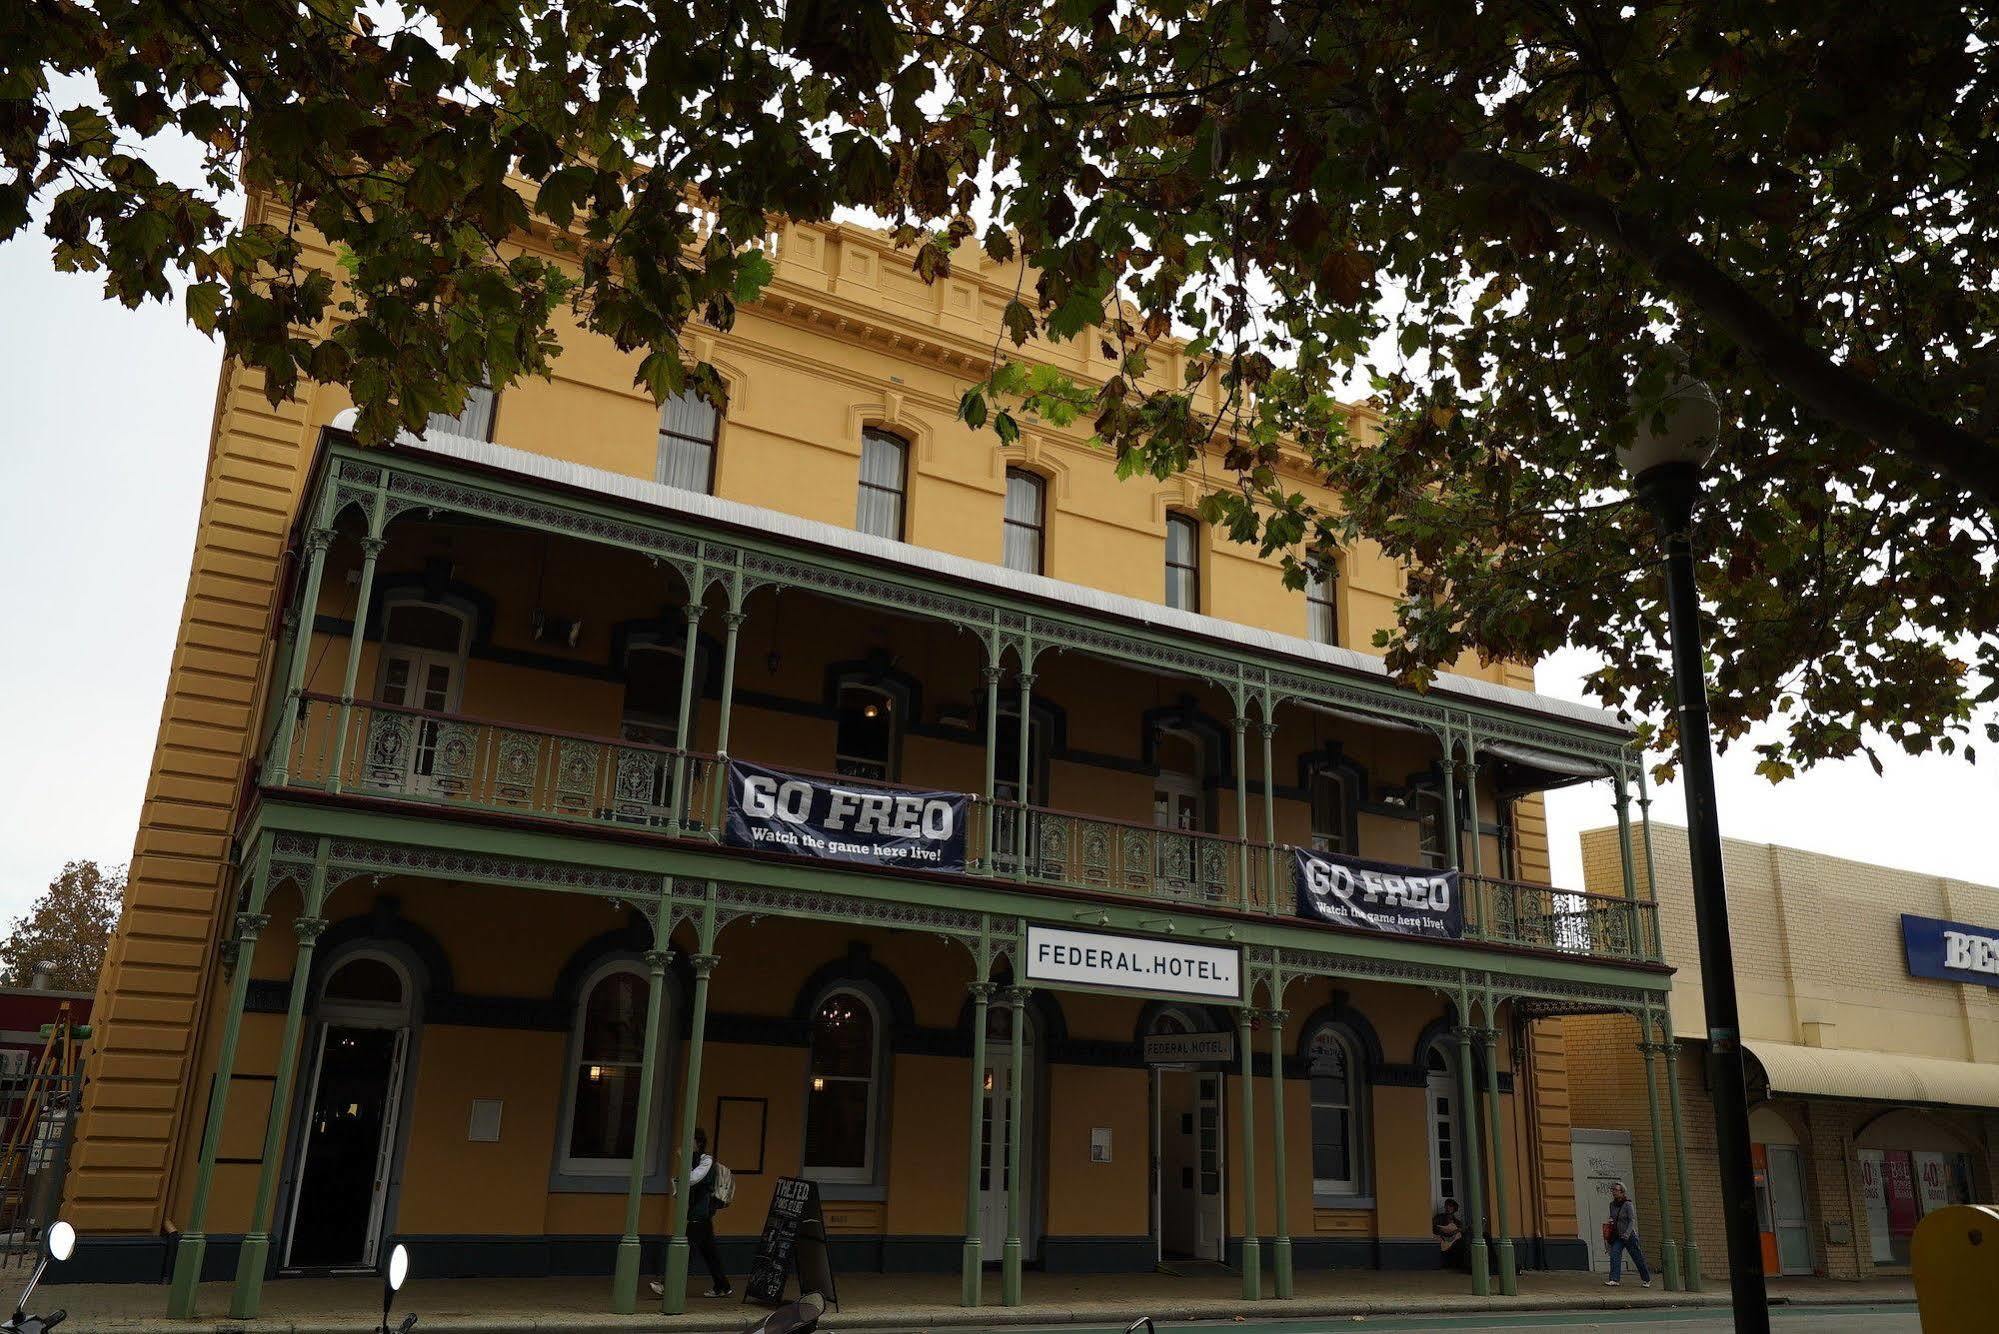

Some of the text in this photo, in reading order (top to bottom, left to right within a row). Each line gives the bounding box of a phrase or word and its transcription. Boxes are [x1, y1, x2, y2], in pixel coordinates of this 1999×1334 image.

[742, 775, 954, 841] GO FREO
[751, 827, 942, 862] Watch the game here live!
[1305, 857, 1450, 913] GO FREO
[1316, 901, 1348, 917] Watch
[1366, 912, 1396, 925] game
[1397, 914, 1421, 928] here
[1423, 916, 1445, 930] live!
[1943, 931, 1999, 975] BE
